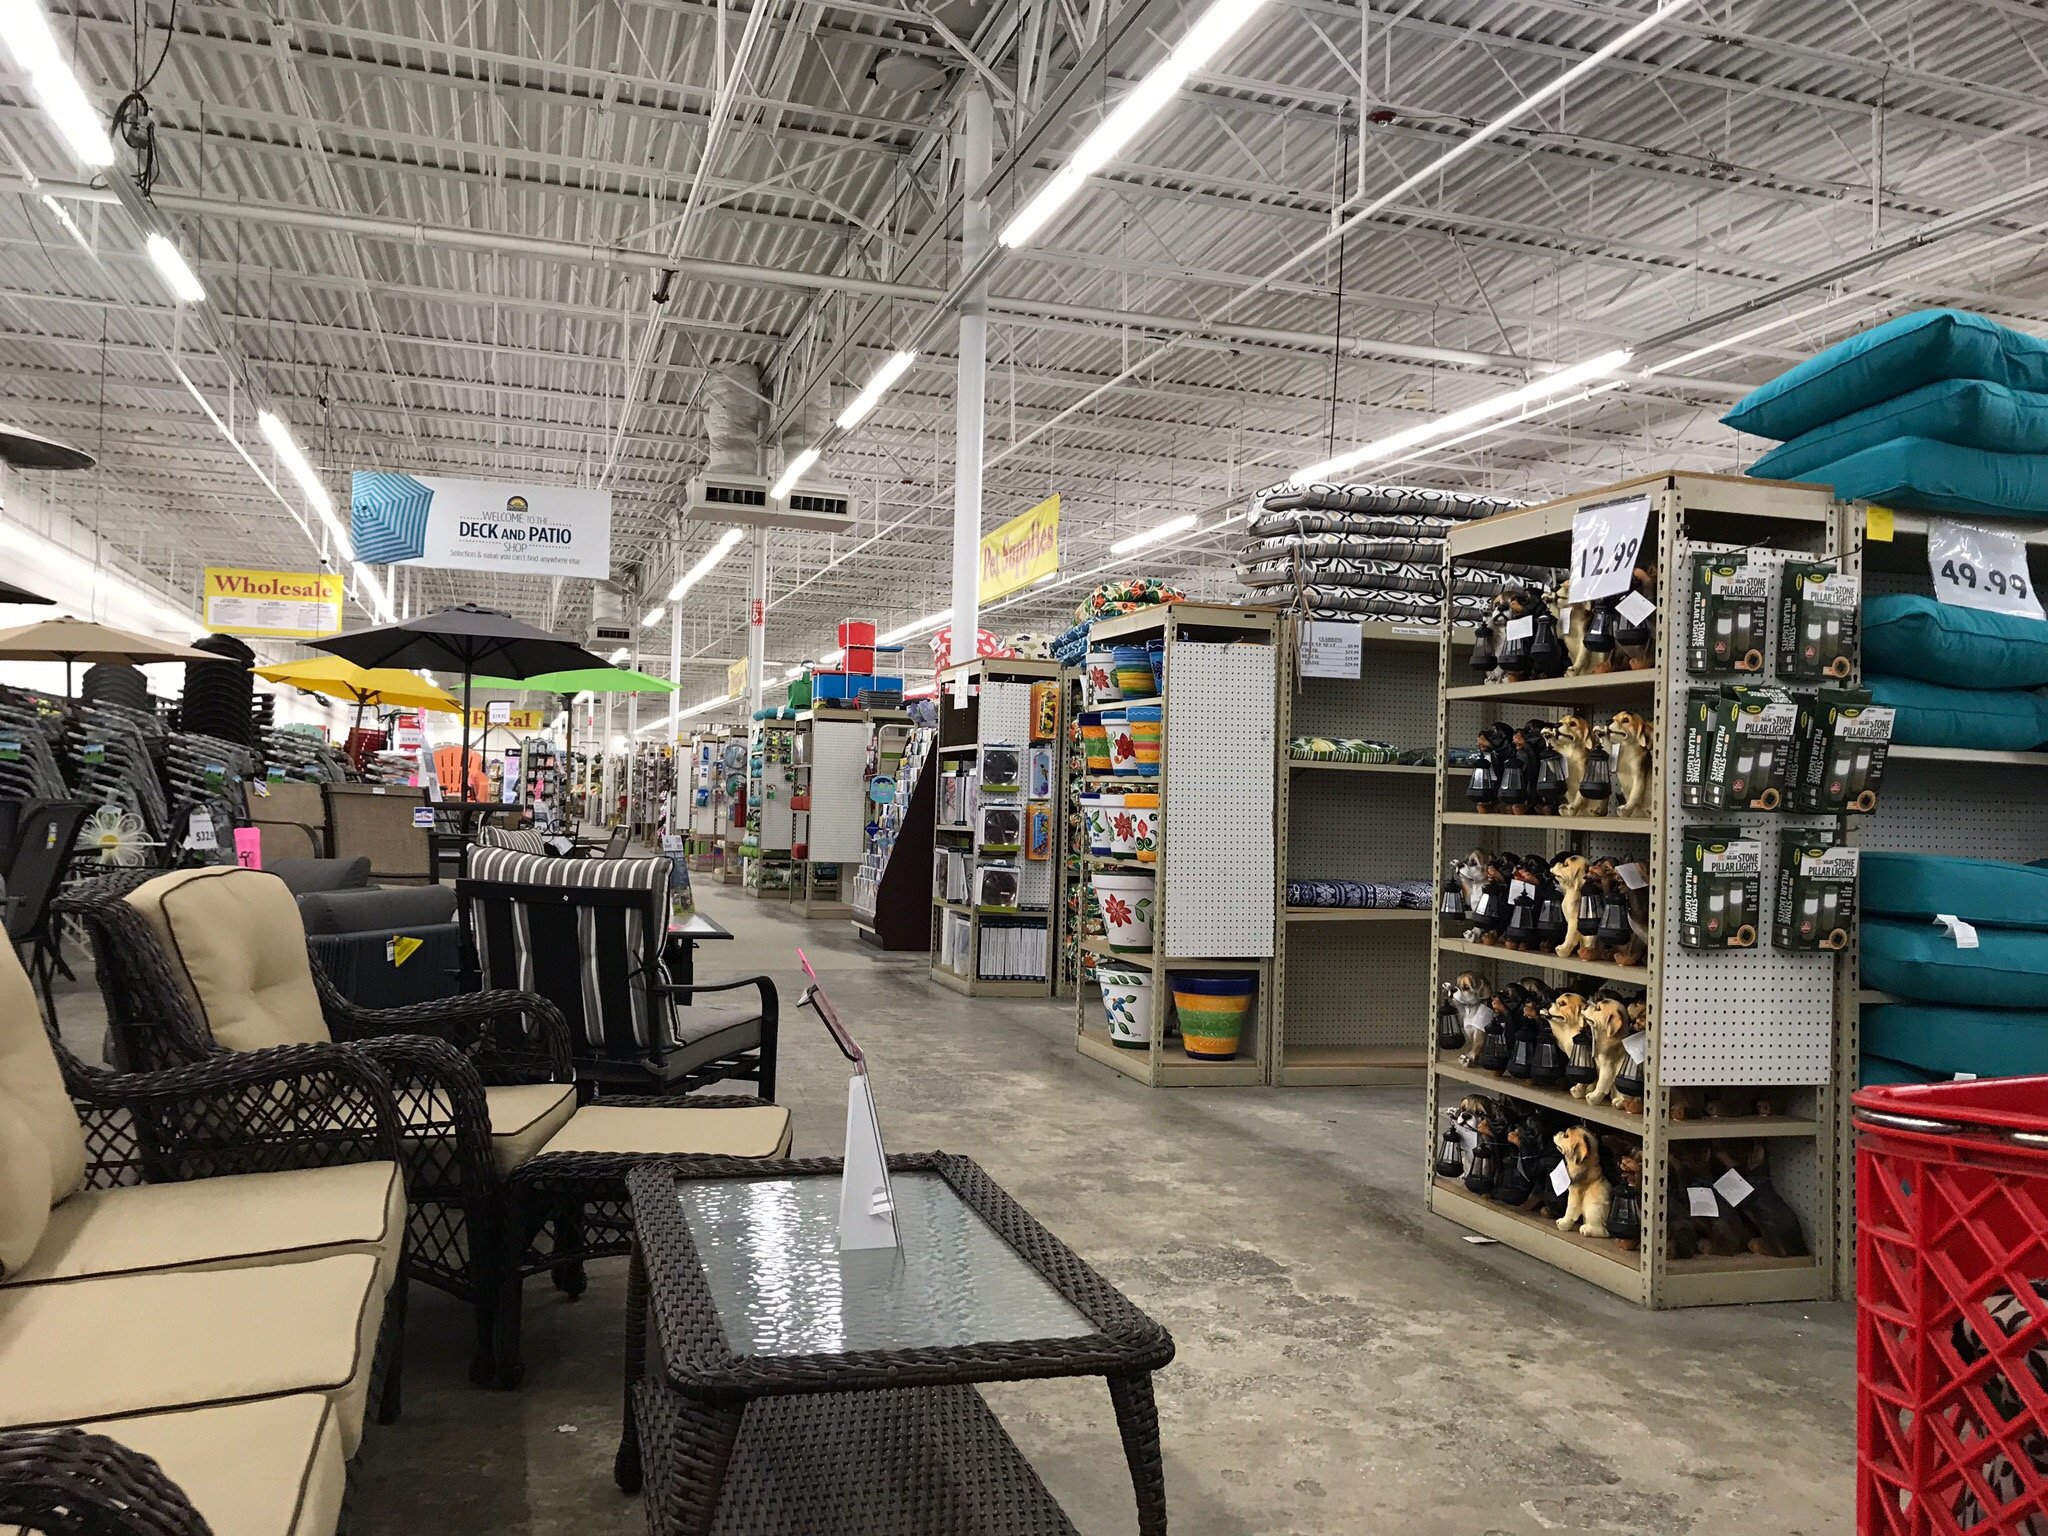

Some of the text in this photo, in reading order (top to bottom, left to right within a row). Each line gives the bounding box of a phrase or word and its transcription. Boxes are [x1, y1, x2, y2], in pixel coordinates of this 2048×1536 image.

[482, 511, 549, 525] WELCOME TO THE
[460, 522, 572, 544] DECK AND PATIO
[504, 542, 528, 552] SHOP
[450, 549, 476, 558] Selection
[483, 552, 498, 560] value
[540, 556, 568, 564] anywhere
[984, 546, 1000, 581] Pet
[1580, 538, 1638, 578] 12.99
[214, 575, 333, 597] Wholesale
[1746, 578, 1766, 587] STONE
[1941, 560, 2027, 599] 49.99
[1720, 586, 1766, 596] PILLAR LIGHTS
[1811, 592, 1854, 604] PILLAR LIGHTS
[1692, 620, 1700, 646] LIGHTS
[1697, 622, 1705, 647] STONE
[1772, 716, 1793, 725] STONE
[1870, 720, 1890, 728] STONE
[1745, 724, 1792, 734] PILLAR LIGHTS
[1843, 727, 1889, 738] PILLAR LIGHTS
[1686, 728, 1696, 782] PILLAR LIGHTS
[1710, 726, 1726, 780] PILLAR LIGHTS
[1692, 758, 1700, 782] STONE
[1715, 757, 1726, 783] STONE
[1738, 854, 1759, 863] STONE
[1834, 858, 1855, 868] STONE
[1711, 863, 1759, 872] PILLAR LIGHTS
[1808, 867, 1854, 876] PILLAR LIGHTS
[1684, 867, 1693, 922] PILLAR LIGHTS
[1690, 898, 1698, 923] STONE
